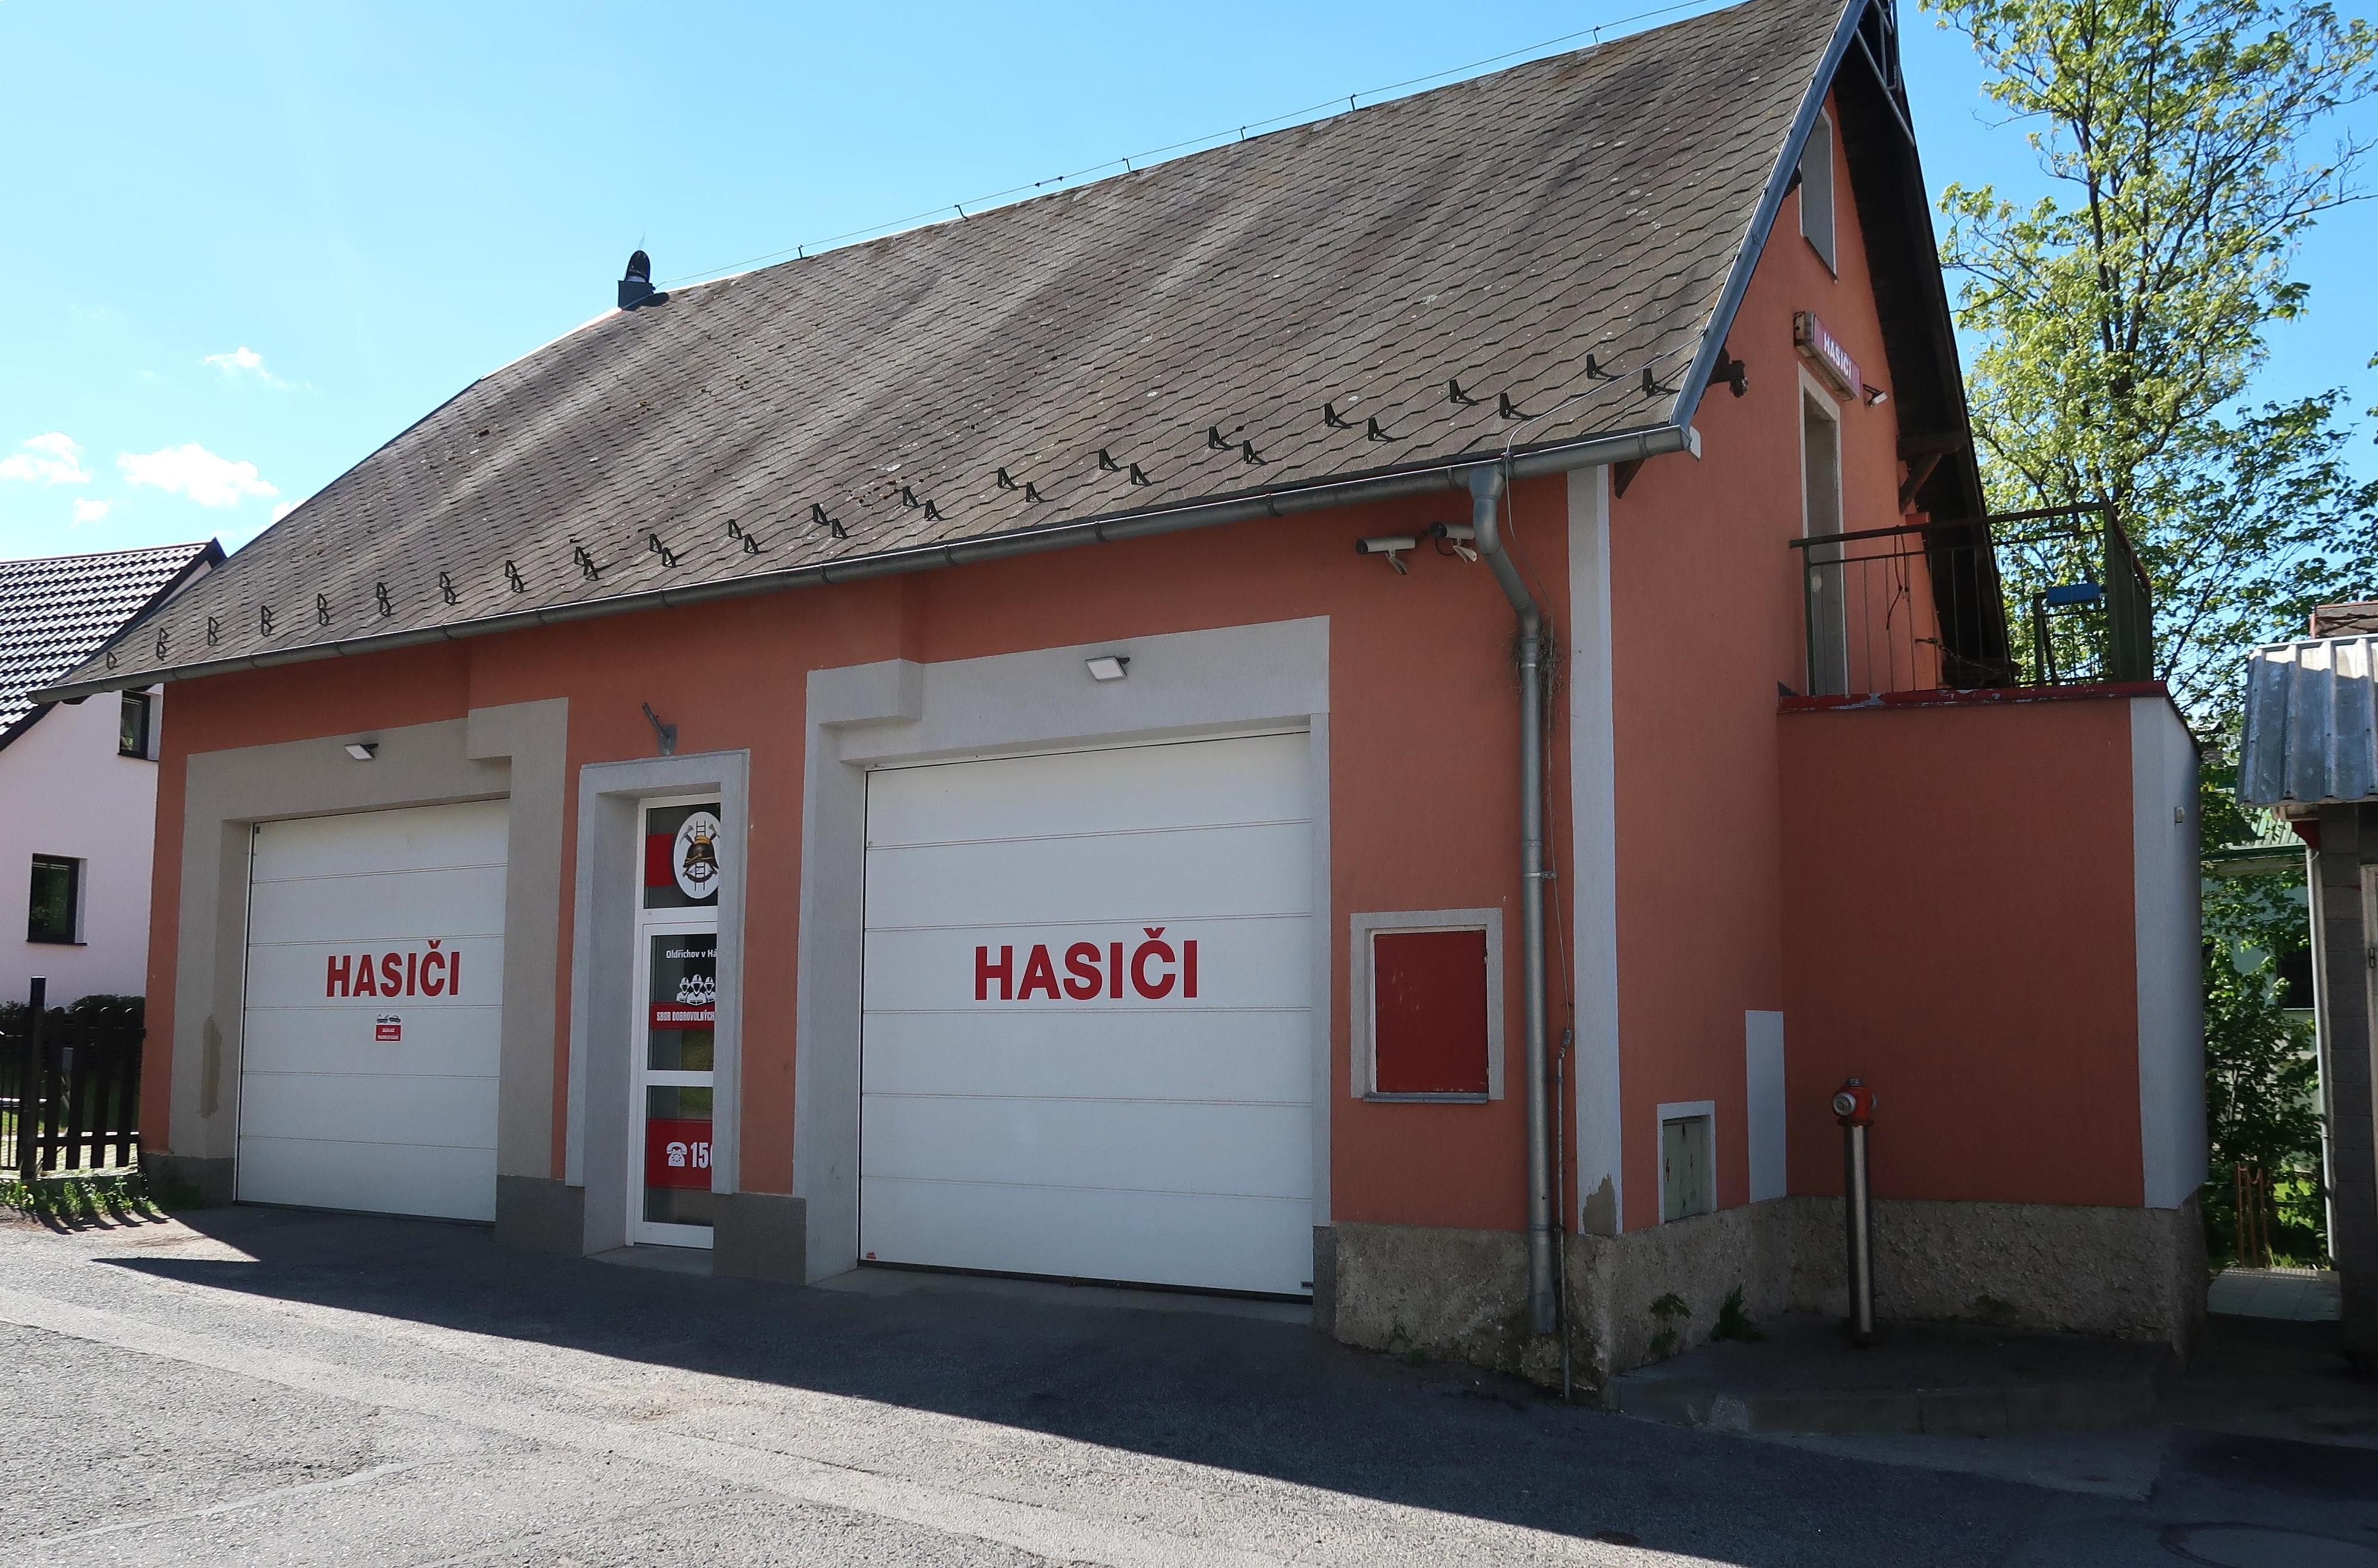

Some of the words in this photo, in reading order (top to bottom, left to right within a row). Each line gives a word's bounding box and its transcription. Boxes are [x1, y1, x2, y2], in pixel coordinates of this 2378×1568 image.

[1823, 332, 1852, 380] HASIČI
[326, 940, 460, 997] HASIČI
[975, 927, 1198, 1000] HASIČI
[690, 1142, 713, 1169] 15
